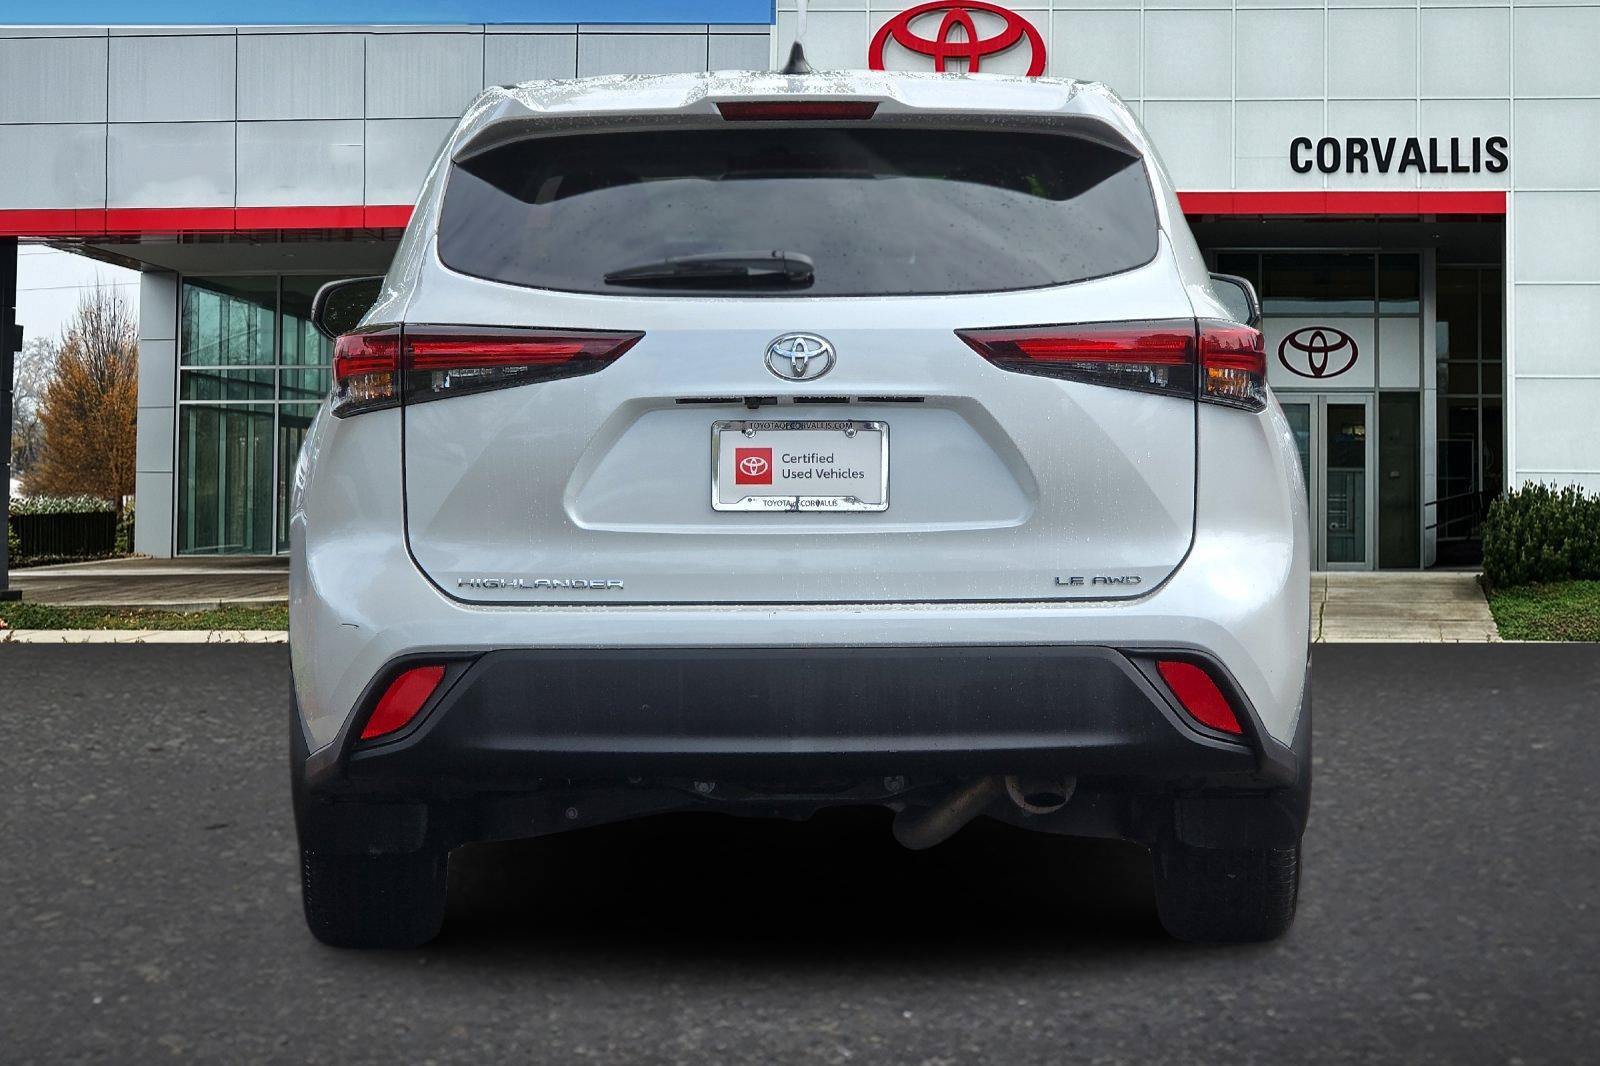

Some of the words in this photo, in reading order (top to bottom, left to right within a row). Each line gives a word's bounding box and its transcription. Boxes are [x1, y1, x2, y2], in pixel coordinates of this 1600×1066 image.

[1290, 136, 1509, 173] CORVALLIS
[781, 452, 834, 464] Certified
[782, 468, 812, 479] Used
[815, 468, 865, 479] Vehicles
[457, 577, 624, 590] HIGHLANDER
[1055, 576, 1085, 586] LE
[1092, 576, 1142, 586] AWD
